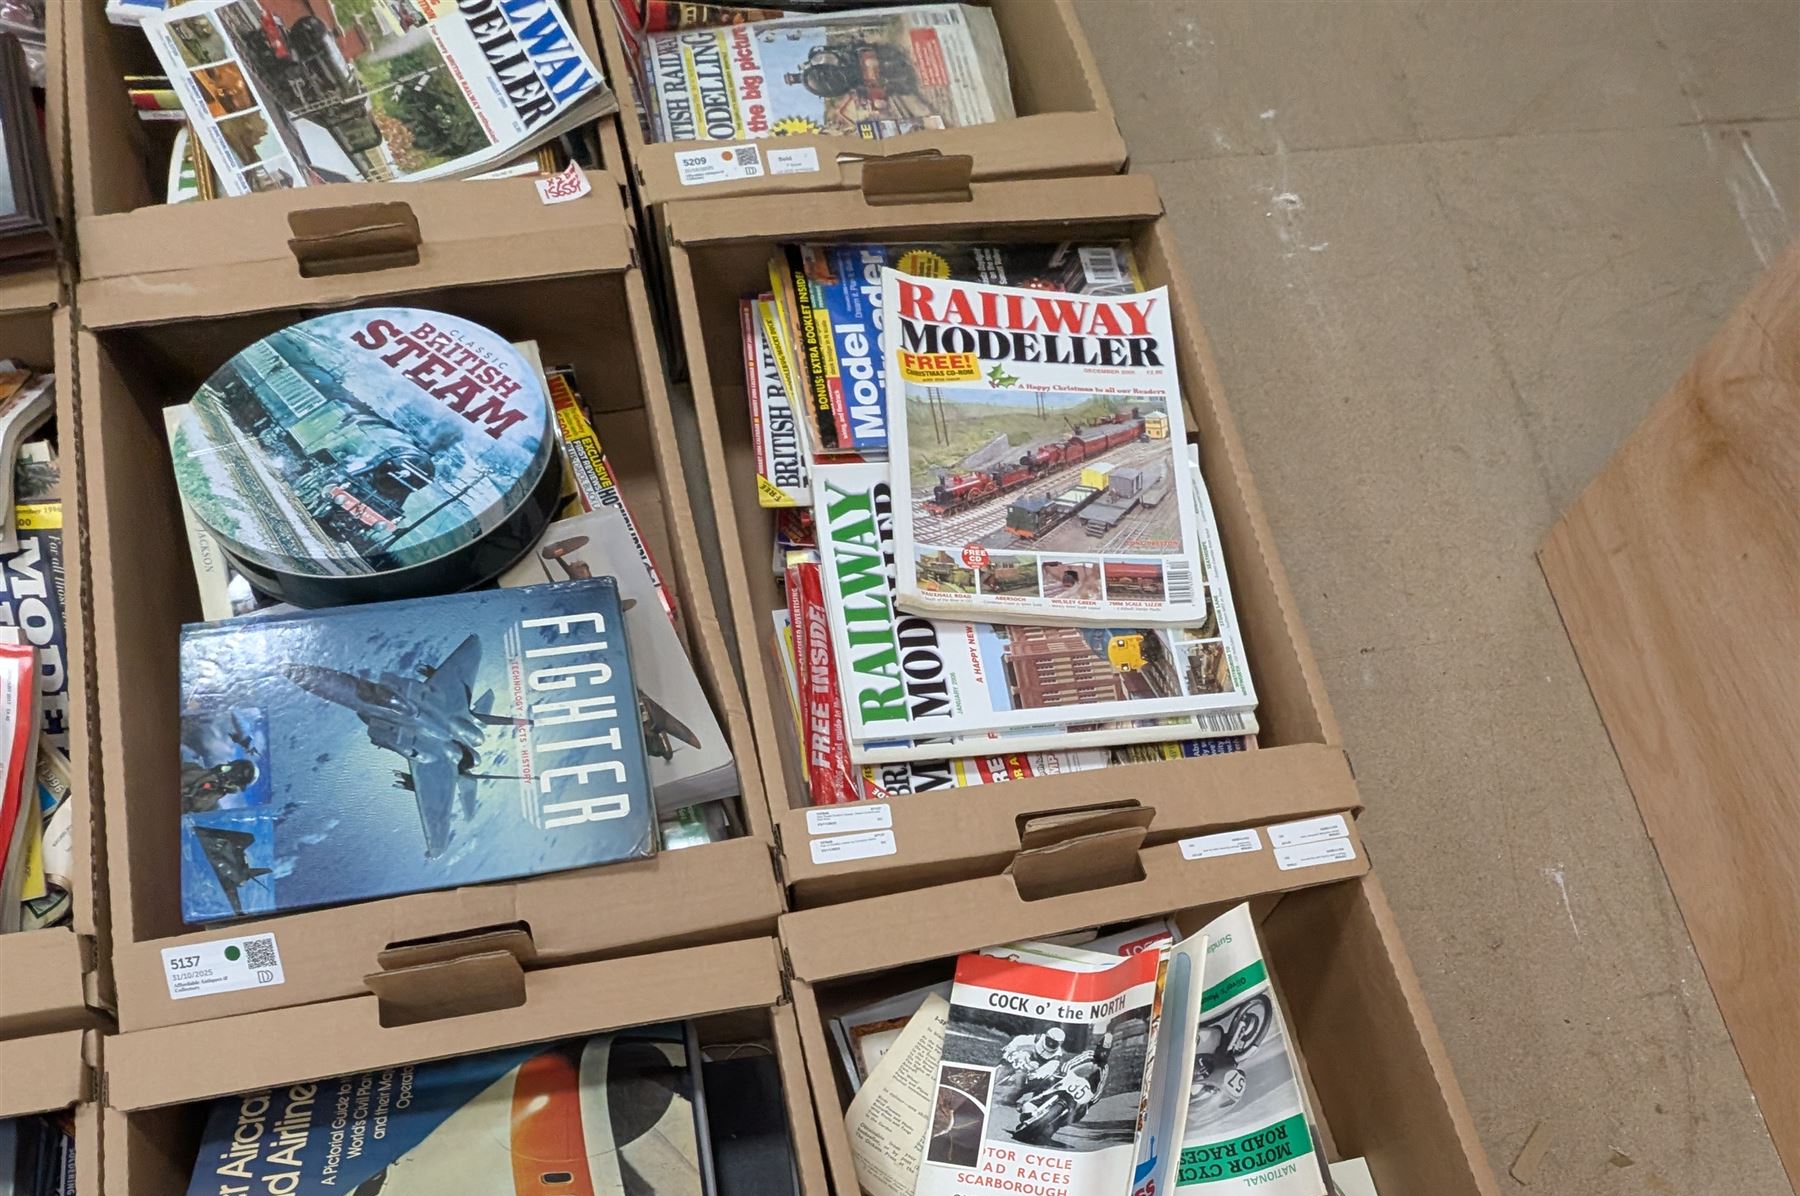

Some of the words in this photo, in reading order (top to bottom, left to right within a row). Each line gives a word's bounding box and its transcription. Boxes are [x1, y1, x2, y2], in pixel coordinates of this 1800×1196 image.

[740, 76, 763, 100] big
[747, 104, 768, 132] the
[682, 157, 707, 167] 5209
[896, 279, 1157, 336] RAILWAY
[801, 305, 817, 343] BOOKLET
[449, 328, 508, 370] CLASSIC
[899, 317, 1164, 367] MODELLER
[410, 322, 524, 398] BRITISH
[810, 347, 823, 374] EXTRA
[905, 353, 971, 370] FREE!
[906, 369, 945, 377] CHRISTMAS
[350, 318, 530, 440] STEAM
[836, 324, 886, 437] Model
[1026, 383, 1051, 392] Happy
[1053, 384, 1093, 393] Christmas
[1133, 387, 1165, 395] Readers
[815, 376, 829, 410] BONUS:
[765, 406, 800, 488] BRITISH
[580, 436, 613, 488] EXCLUSIVE
[48, 534, 59, 553] For
[54, 555, 62, 572] all
[963, 549, 987, 557] FREE
[825, 477, 908, 728] RAILWAY
[921, 590, 952, 598] VAUXHALL
[791, 588, 802, 629] ADVERTISING
[809, 602, 829, 692] INSIDE!
[966, 626, 976, 644] NEW
[970, 648, 982, 674] HAPPY
[954, 687, 963, 714] JANUARY
[512, 661, 523, 711] TECHNOLOGY
[522, 749, 531, 784] HISTORY
[520, 610, 632, 831] FIGHTER
[834, 719, 843, 740] guide
[812, 702, 831, 768] FREE
[835, 742, 844, 769] pocket
[171, 956, 200, 970] 5137
[172, 969, 213, 981] 31/10/2025
[1222, 976, 1247, 996] Oliver's
[988, 991, 1030, 1015] COCK
[1036, 1001, 1051, 1018] o'
[1057, 1001, 1084, 1021] the
[1090, 993, 1128, 1020] NORTH
[1065, 1077, 1092, 1103] 35
[1228, 1071, 1245, 1092] 57
[331, 1095, 349, 1129] Guide
[352, 1094, 369, 1118] Civil
[375, 1088, 389, 1113] their
[346, 1118, 363, 1160] World's
[373, 1114, 386, 1139] and
[1241, 1125, 1288, 1152] ROAD
[324, 1130, 344, 1174] Pictorial
[1025, 1154, 1073, 1170] CYCLE
[1229, 1141, 1293, 1173] MOTOR
[321, 1174, 336, 1185] A
[1017, 1168, 1071, 1186] RACES
[1243, 1163, 1297, 1188] NATIONAL
